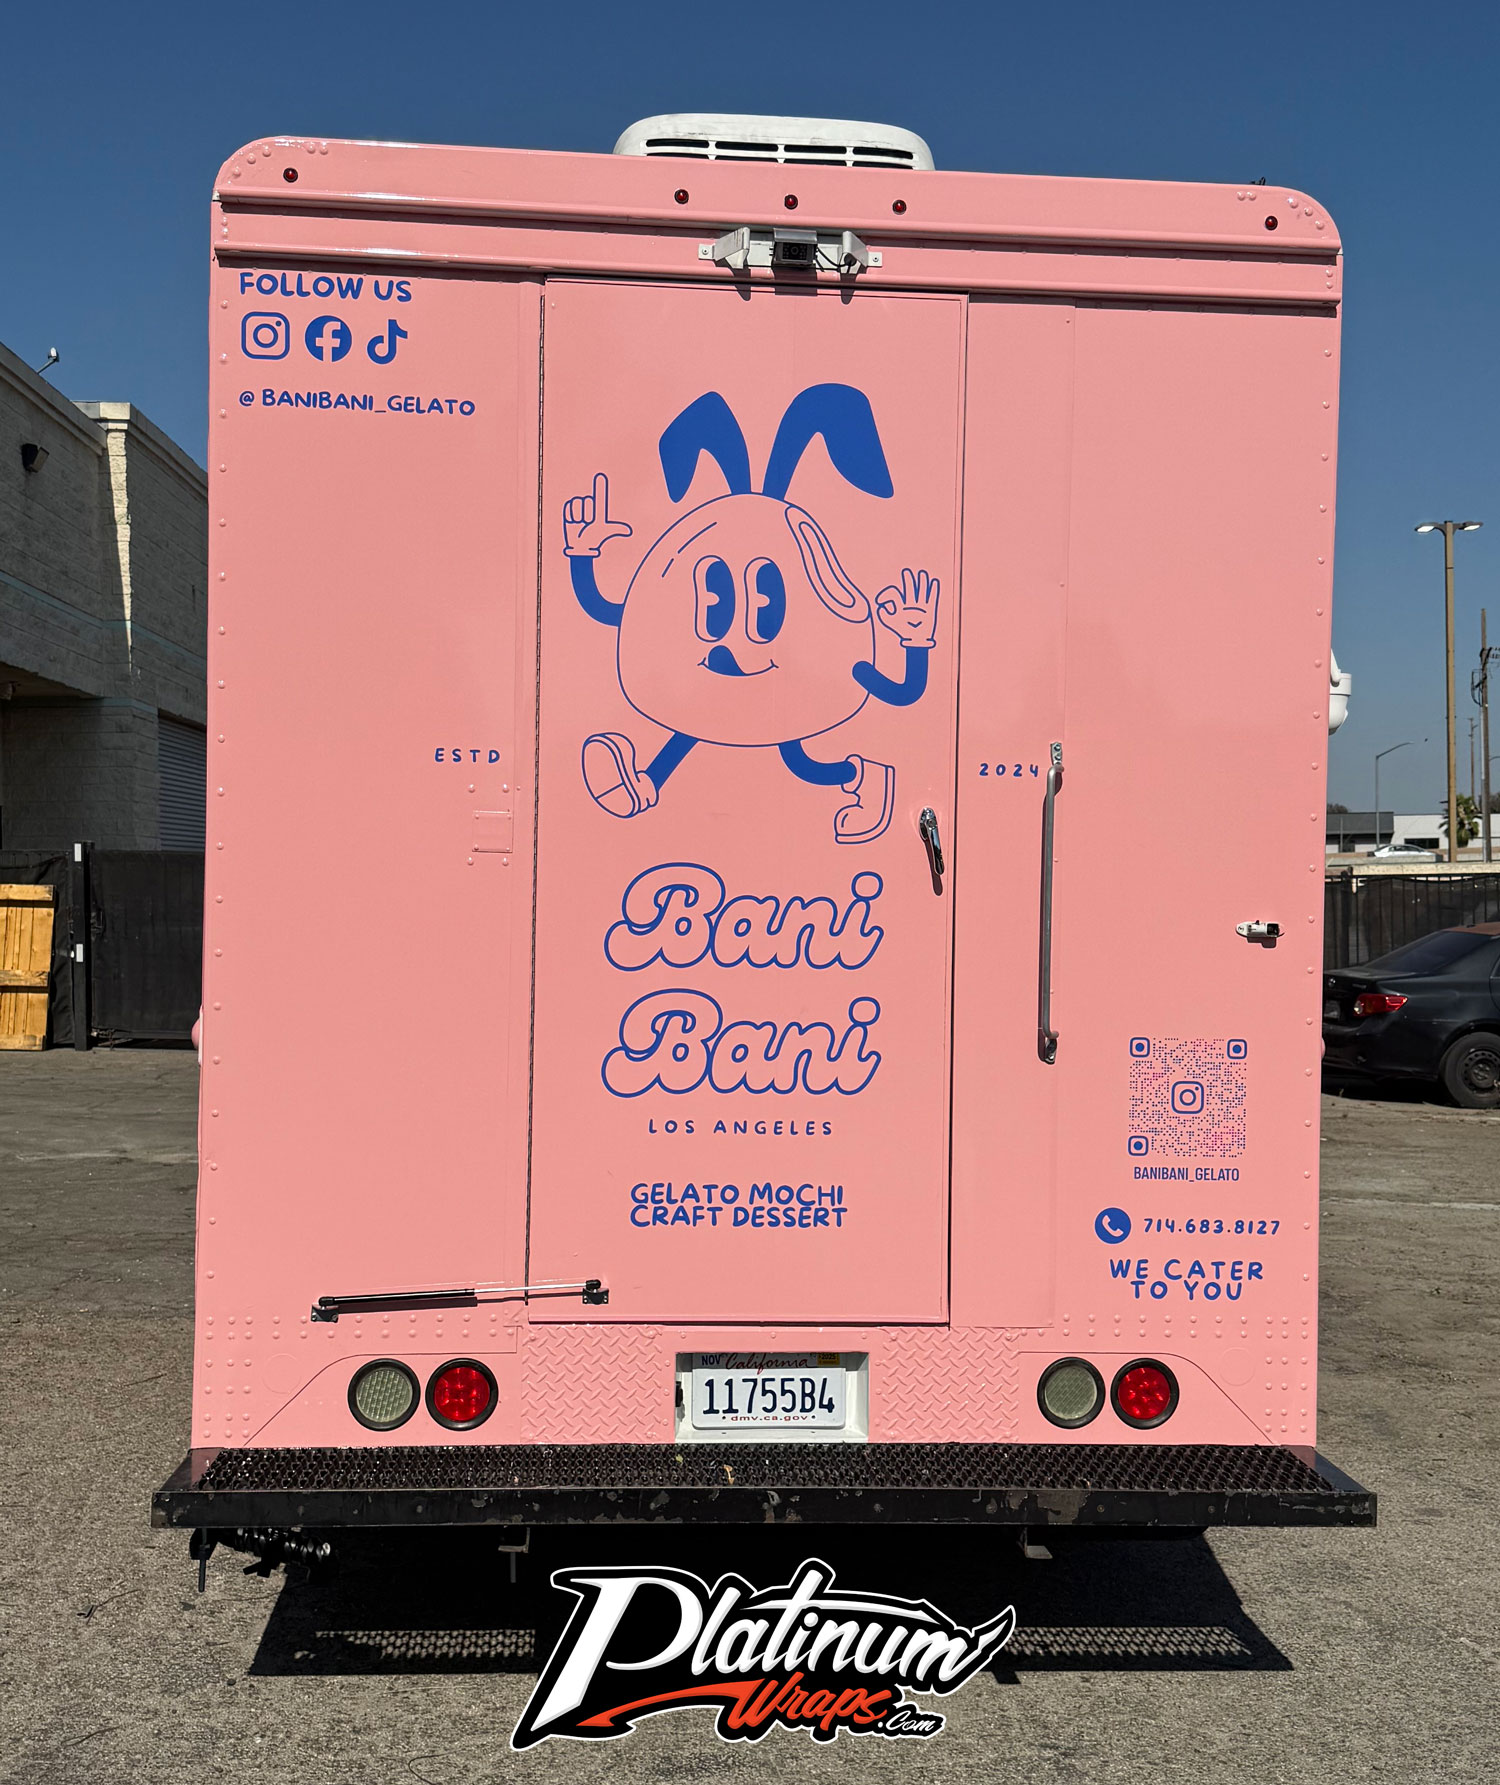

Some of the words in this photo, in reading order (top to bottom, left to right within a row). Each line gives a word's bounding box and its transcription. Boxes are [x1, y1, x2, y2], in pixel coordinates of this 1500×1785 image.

[240, 272, 363, 299] FOLLOW
[374, 280, 412, 302] US
[262, 389, 475, 416] BANIBANI_GELATO
[435, 748, 500, 763] ESTD
[979, 763, 1038, 777] 2024
[604, 862, 884, 972] Bani
[601, 988, 881, 1098] Bani
[649, 1119, 695, 1134] LOS
[713, 1120, 832, 1136] ANGELES
[1134, 1166, 1240, 1182] BANIBANI_GELATO
[631, 1183, 739, 1204] GELATO
[749, 1183, 843, 1206] MOCHI
[630, 1205, 723, 1227] CRAFT
[733, 1207, 847, 1228] DESSERT
[1144, 1218, 1280, 1235] 714.683.8127
[1110, 1259, 1149, 1279] WE
[1164, 1259, 1263, 1280] CATER
[1131, 1281, 1168, 1299] TO
[1184, 1280, 1243, 1300] YOU
[701, 1355, 721, 1366] NOV
[725, 1353, 811, 1375] California
[703, 1377, 835, 1414] 11755B4
